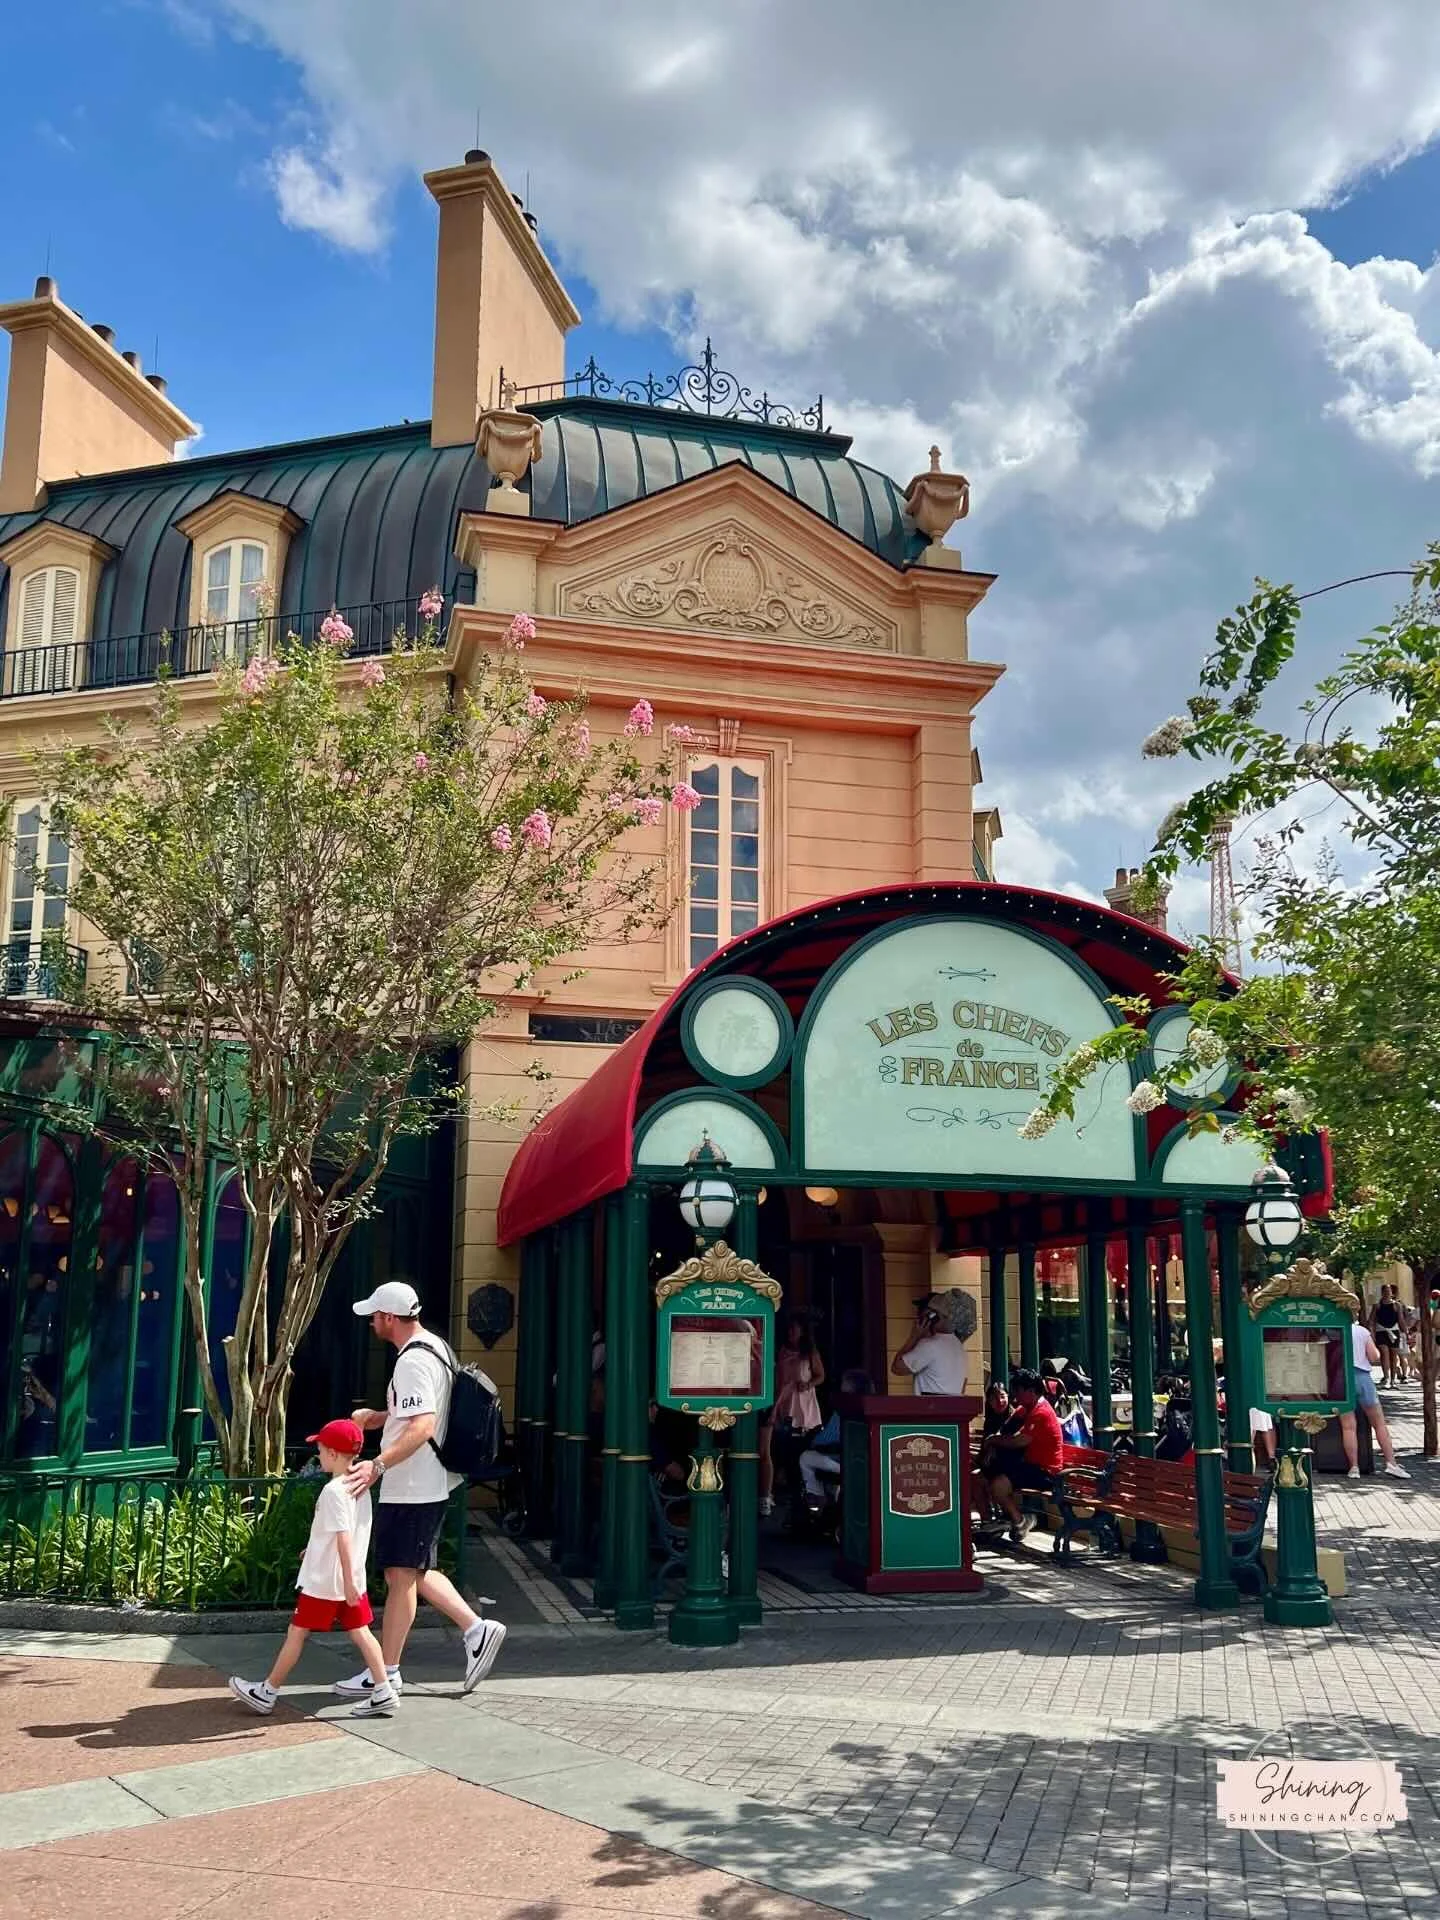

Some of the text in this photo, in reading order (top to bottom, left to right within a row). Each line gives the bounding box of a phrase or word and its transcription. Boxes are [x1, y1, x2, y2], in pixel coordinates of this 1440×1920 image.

[865, 1000, 1072, 1058] LES CHEFS
[956, 1038, 984, 1058] de
[900, 1056, 1040, 1092] FRANCE
[402, 1396, 422, 1408] GAP
